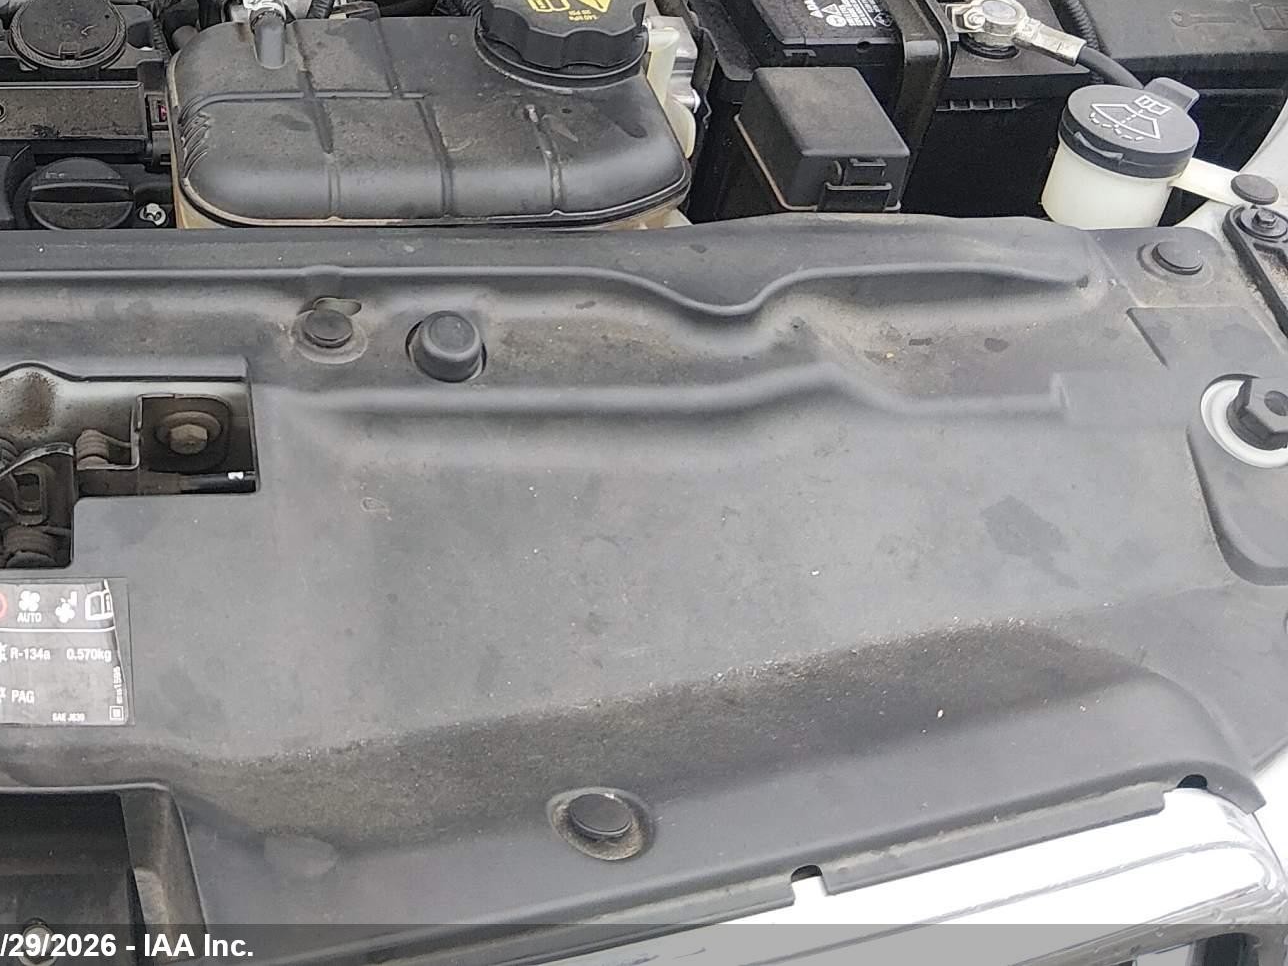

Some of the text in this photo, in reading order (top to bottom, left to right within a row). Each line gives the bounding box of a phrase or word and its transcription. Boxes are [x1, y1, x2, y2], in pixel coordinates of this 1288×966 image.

[17, 612, 42, 623] AUTO
[10, 647, 112, 663] R-134a 0.570kg
[11, 689, 35, 704] PAG
